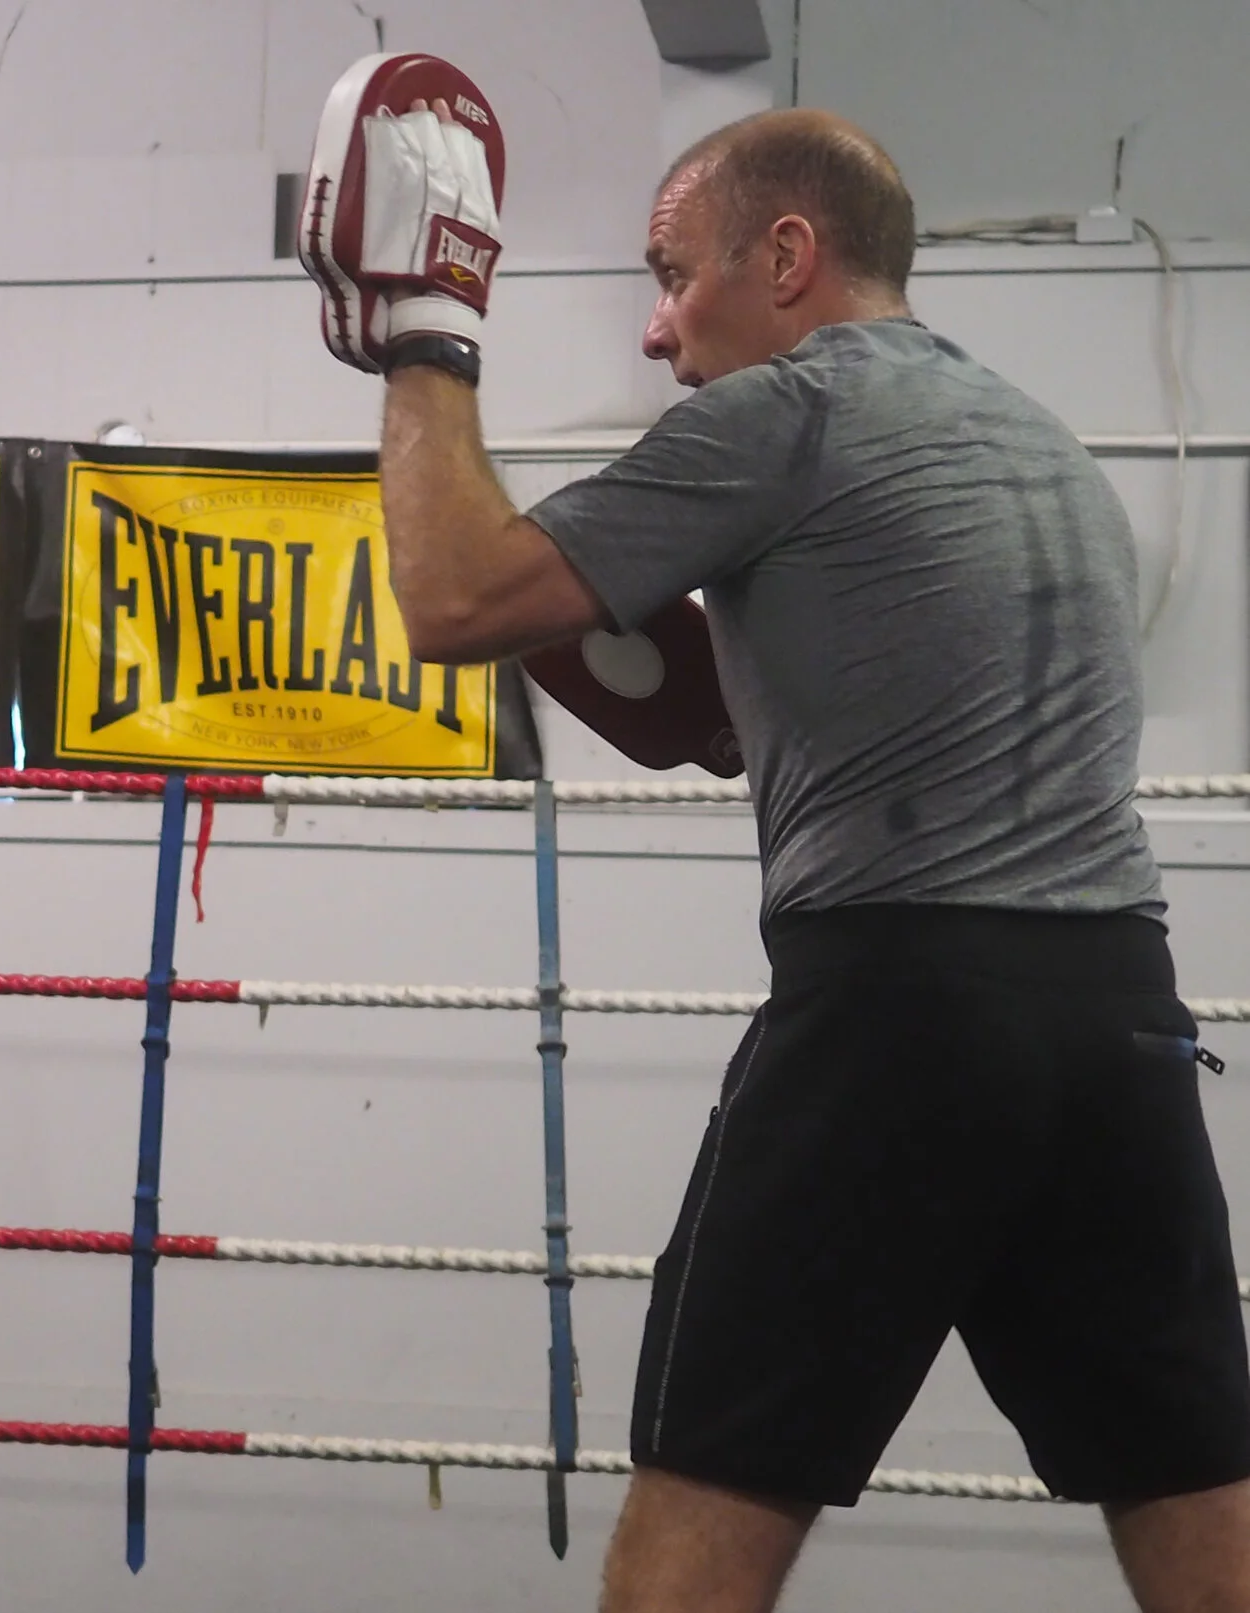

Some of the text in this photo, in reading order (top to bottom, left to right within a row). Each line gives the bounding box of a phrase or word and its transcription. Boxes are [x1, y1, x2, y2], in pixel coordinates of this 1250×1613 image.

[178, 490, 375, 519] BOXING EQUIPMENT
[90, 489, 463, 734] EVERLA
[191, 721, 371, 751] NEW YORK NEW YORK
